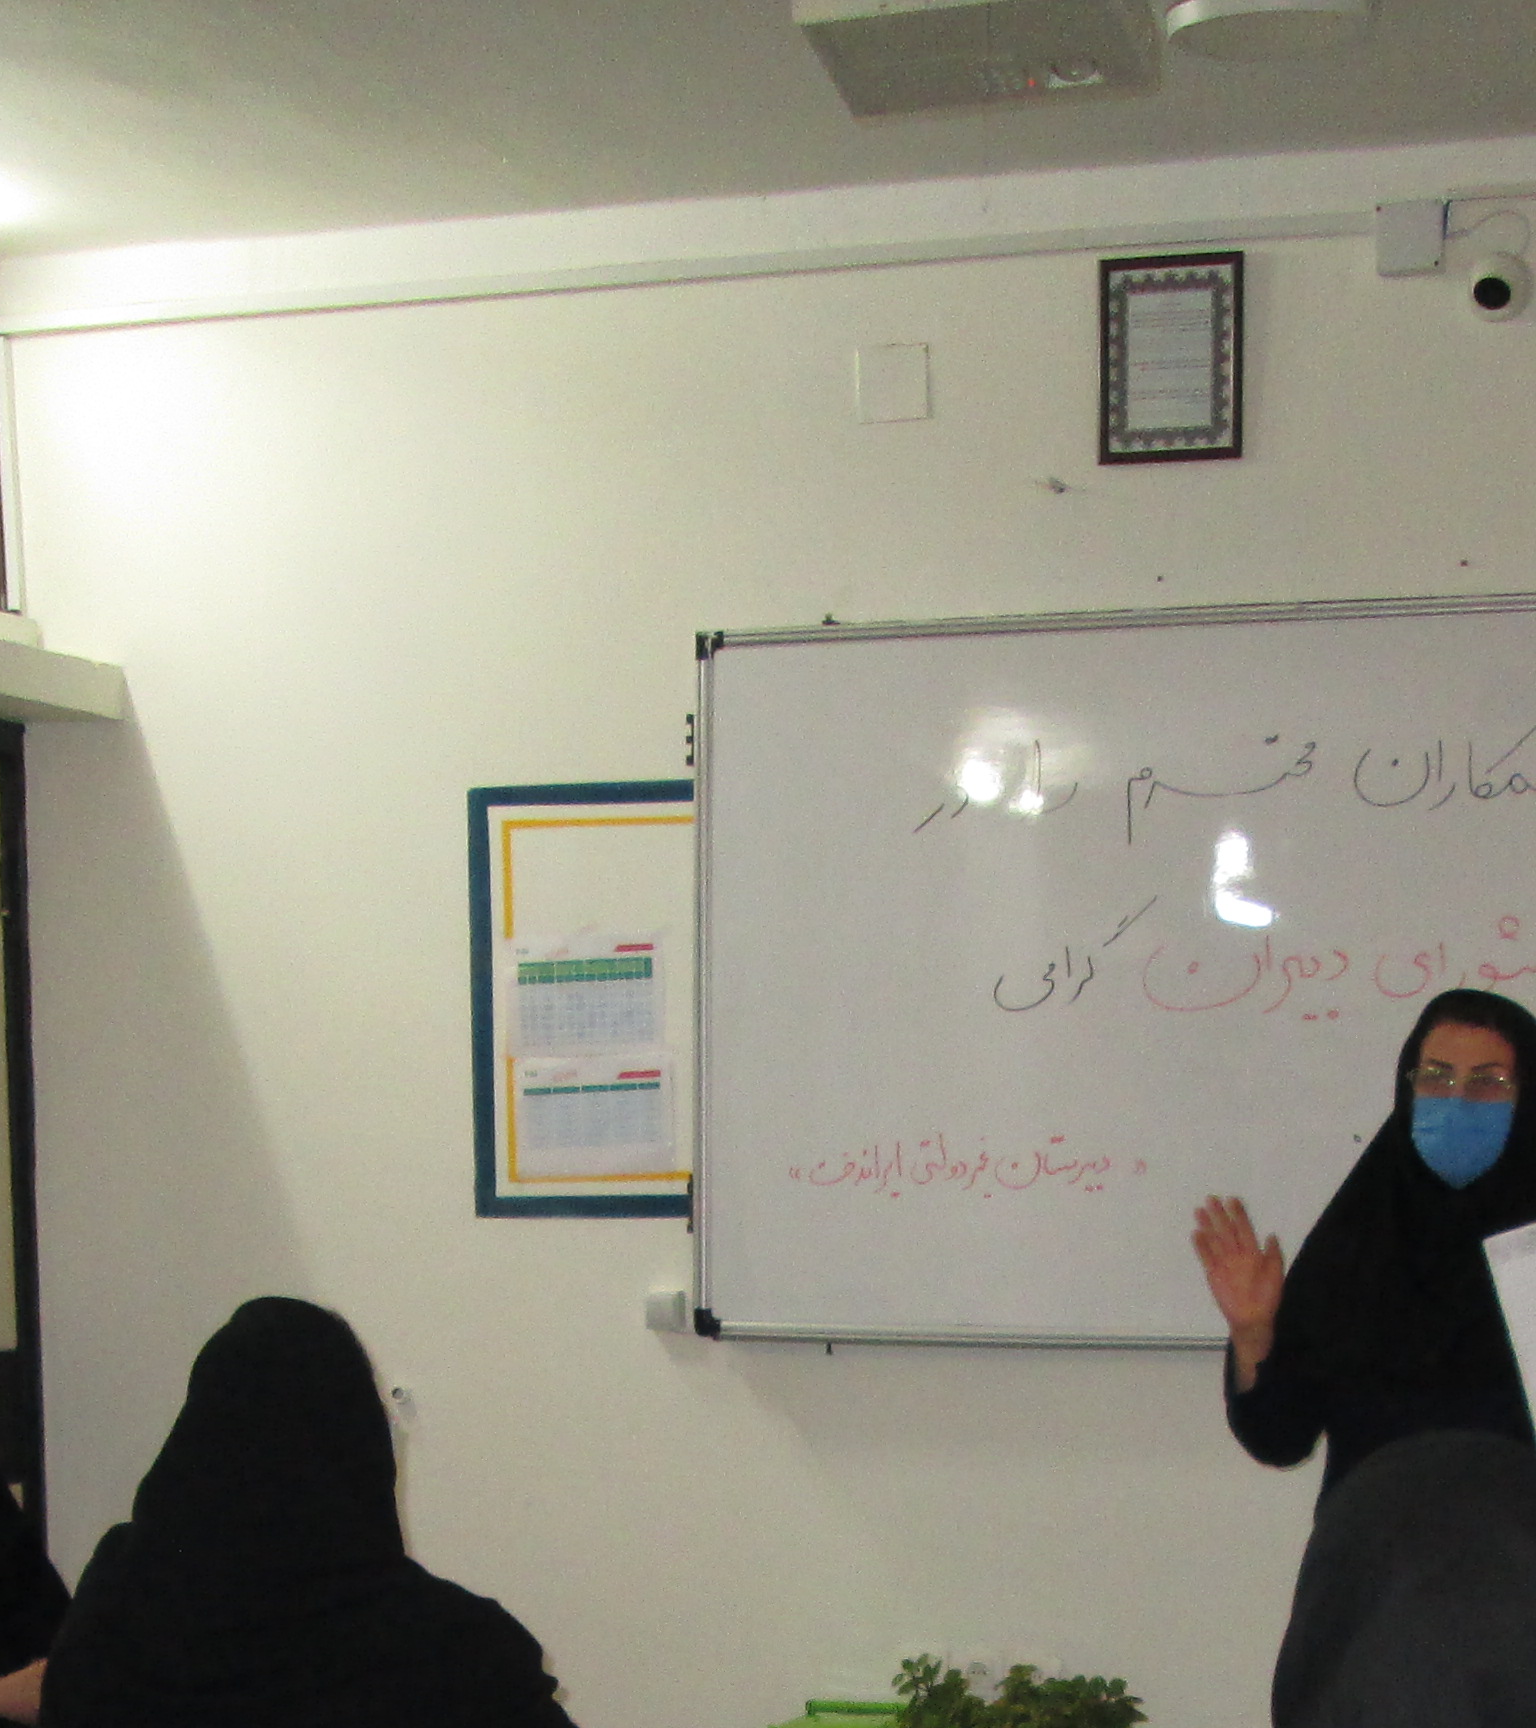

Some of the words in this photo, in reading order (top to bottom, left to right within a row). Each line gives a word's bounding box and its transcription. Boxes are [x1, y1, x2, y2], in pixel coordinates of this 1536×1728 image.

[1127, 734, 1318, 845] محترم
[993, 894, 1158, 1013] گرامی
[1142, 934, 1350, 1022] دبیران
